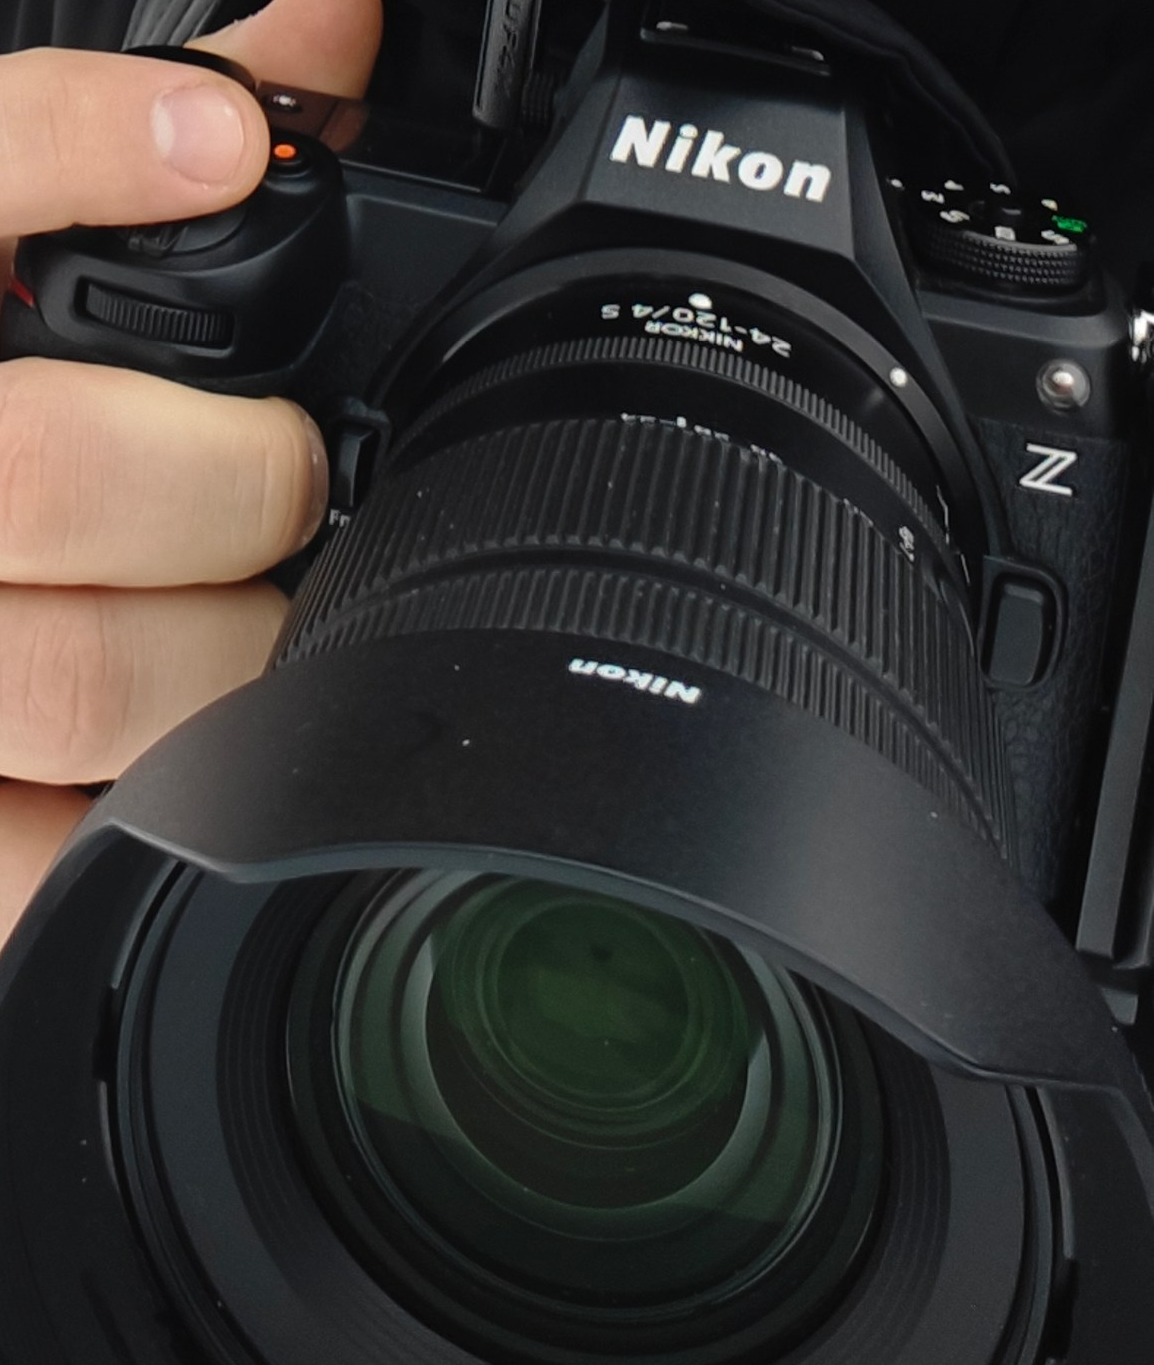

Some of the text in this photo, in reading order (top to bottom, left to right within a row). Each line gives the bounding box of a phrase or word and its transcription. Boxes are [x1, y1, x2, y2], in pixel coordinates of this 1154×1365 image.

[609, 114, 831, 203] Nikon
[600, 303, 793, 358] 24-120/4 S
[644, 320, 744, 353] NIKKOR
[1019, 442, 1078, 497] Z
[567, 657, 703, 704] Nikon
